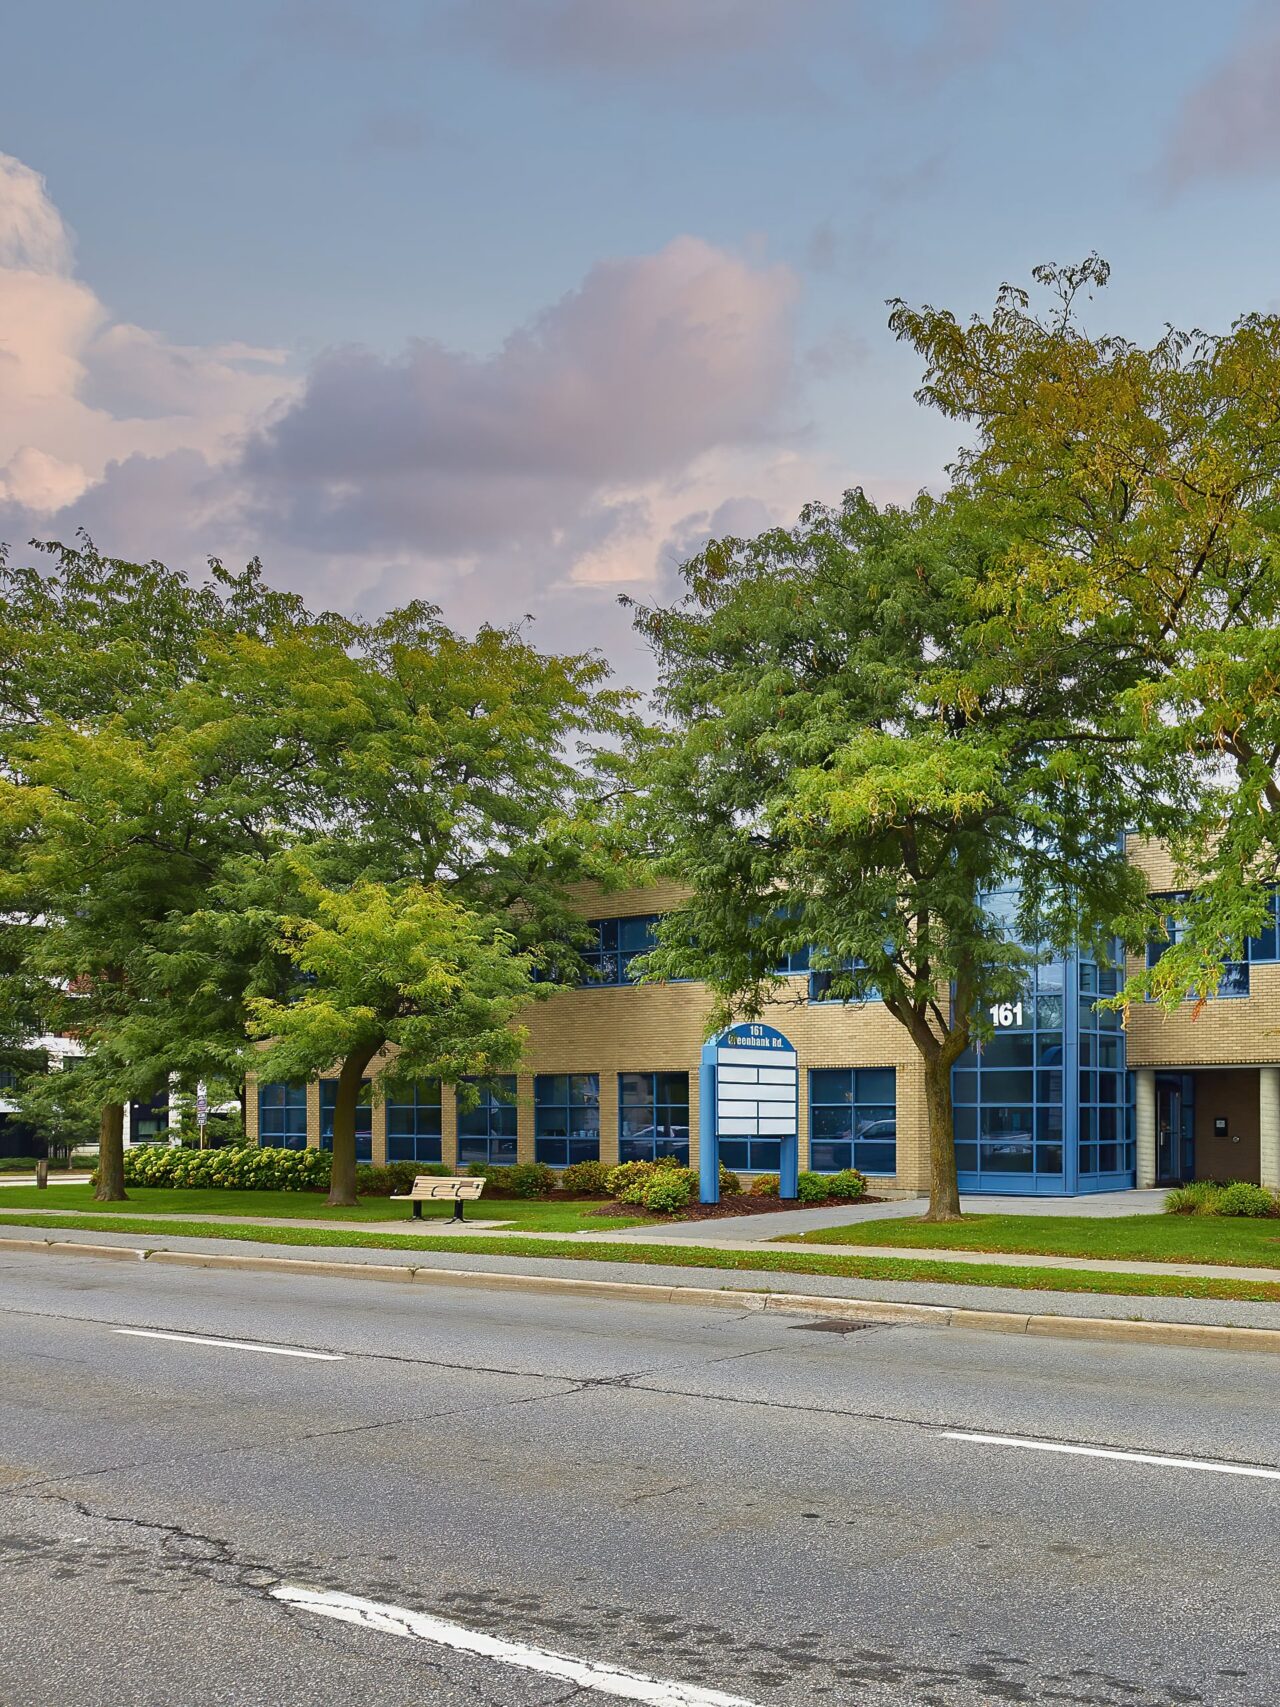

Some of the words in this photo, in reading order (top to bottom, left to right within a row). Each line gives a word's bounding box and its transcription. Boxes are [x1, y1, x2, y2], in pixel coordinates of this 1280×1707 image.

[990, 1002, 1022, 1026] 161
[750, 1025, 763, 1036] 161
[772, 1037, 784, 1048] Rd.
